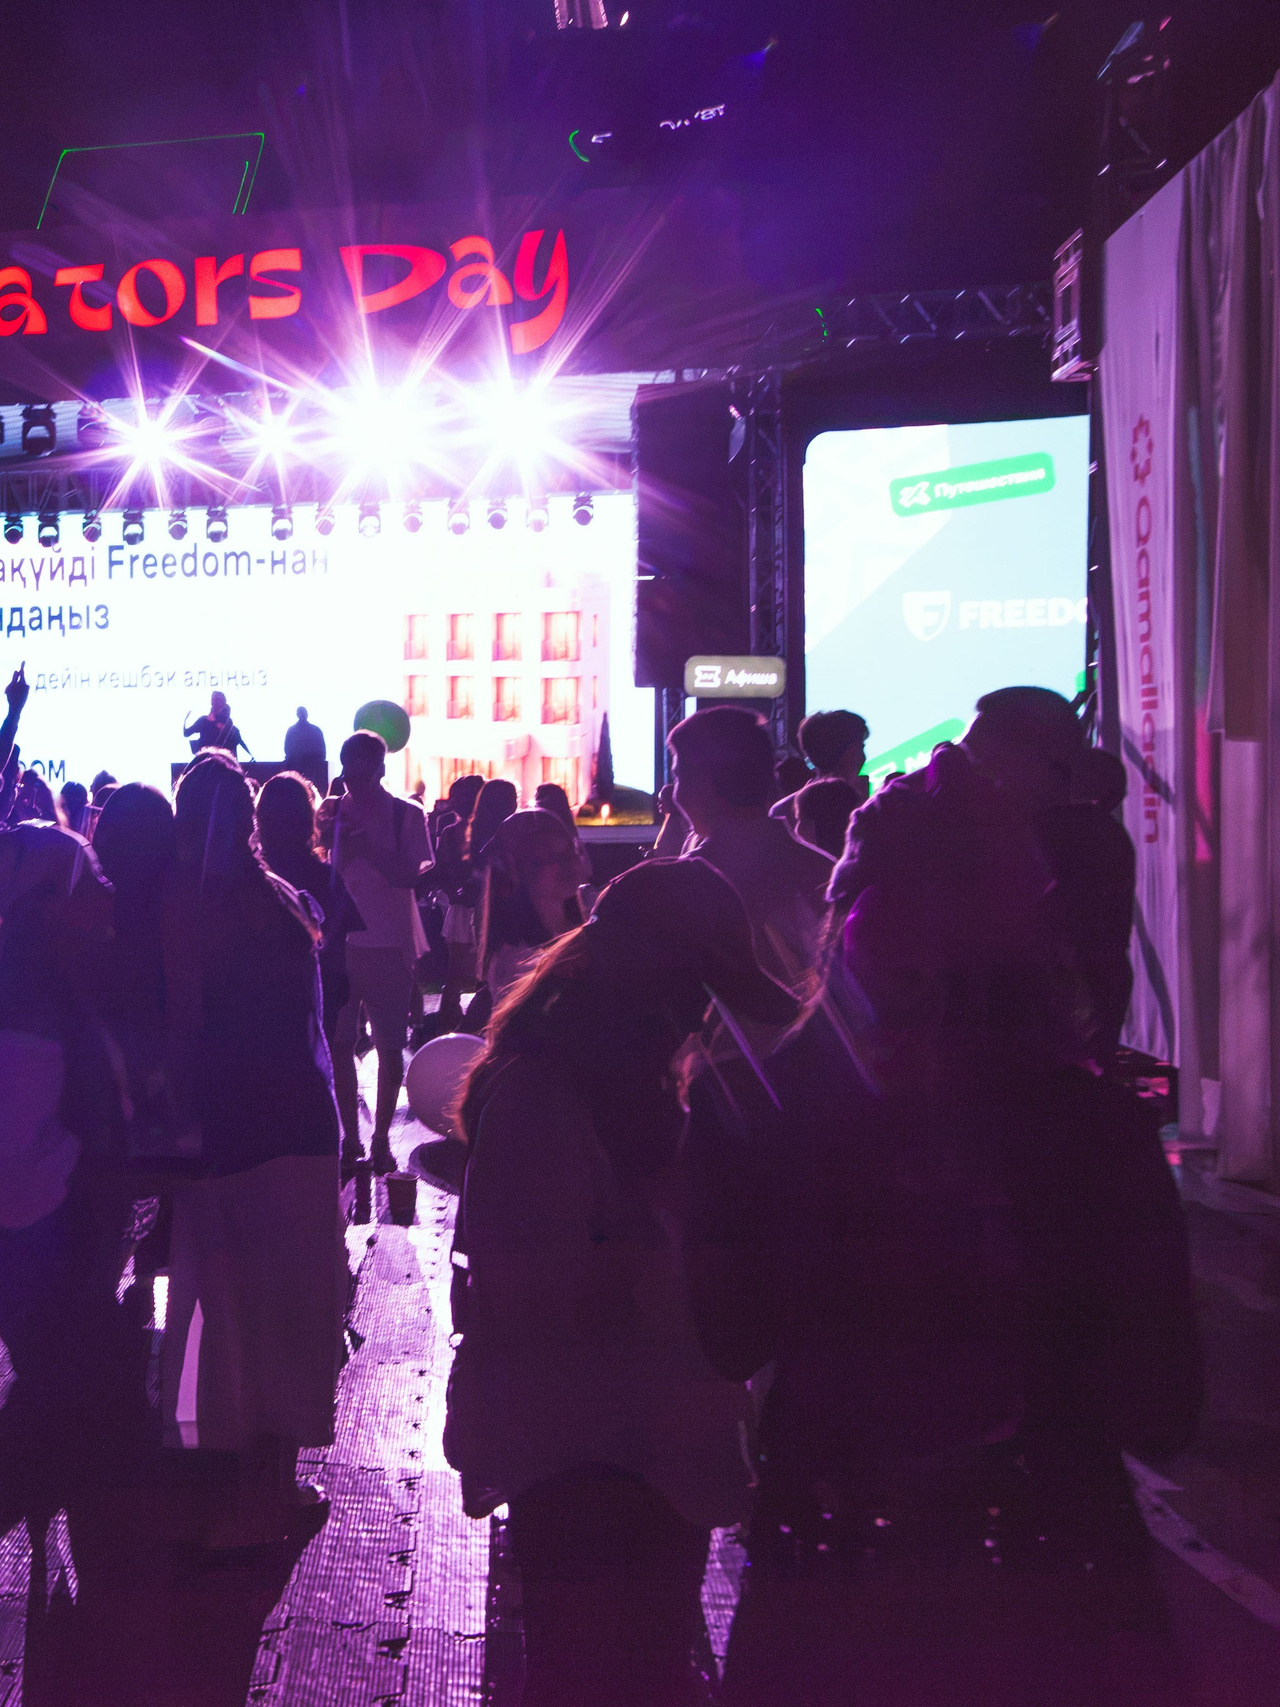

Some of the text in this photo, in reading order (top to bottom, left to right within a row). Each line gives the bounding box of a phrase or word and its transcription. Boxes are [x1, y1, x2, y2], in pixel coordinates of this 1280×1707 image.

[339, 228, 570, 355] Day
[35, 667, 91, 693] дейін
[98, 664, 176, 689] кешбэк
[183, 668, 268, 691] алыңыз
